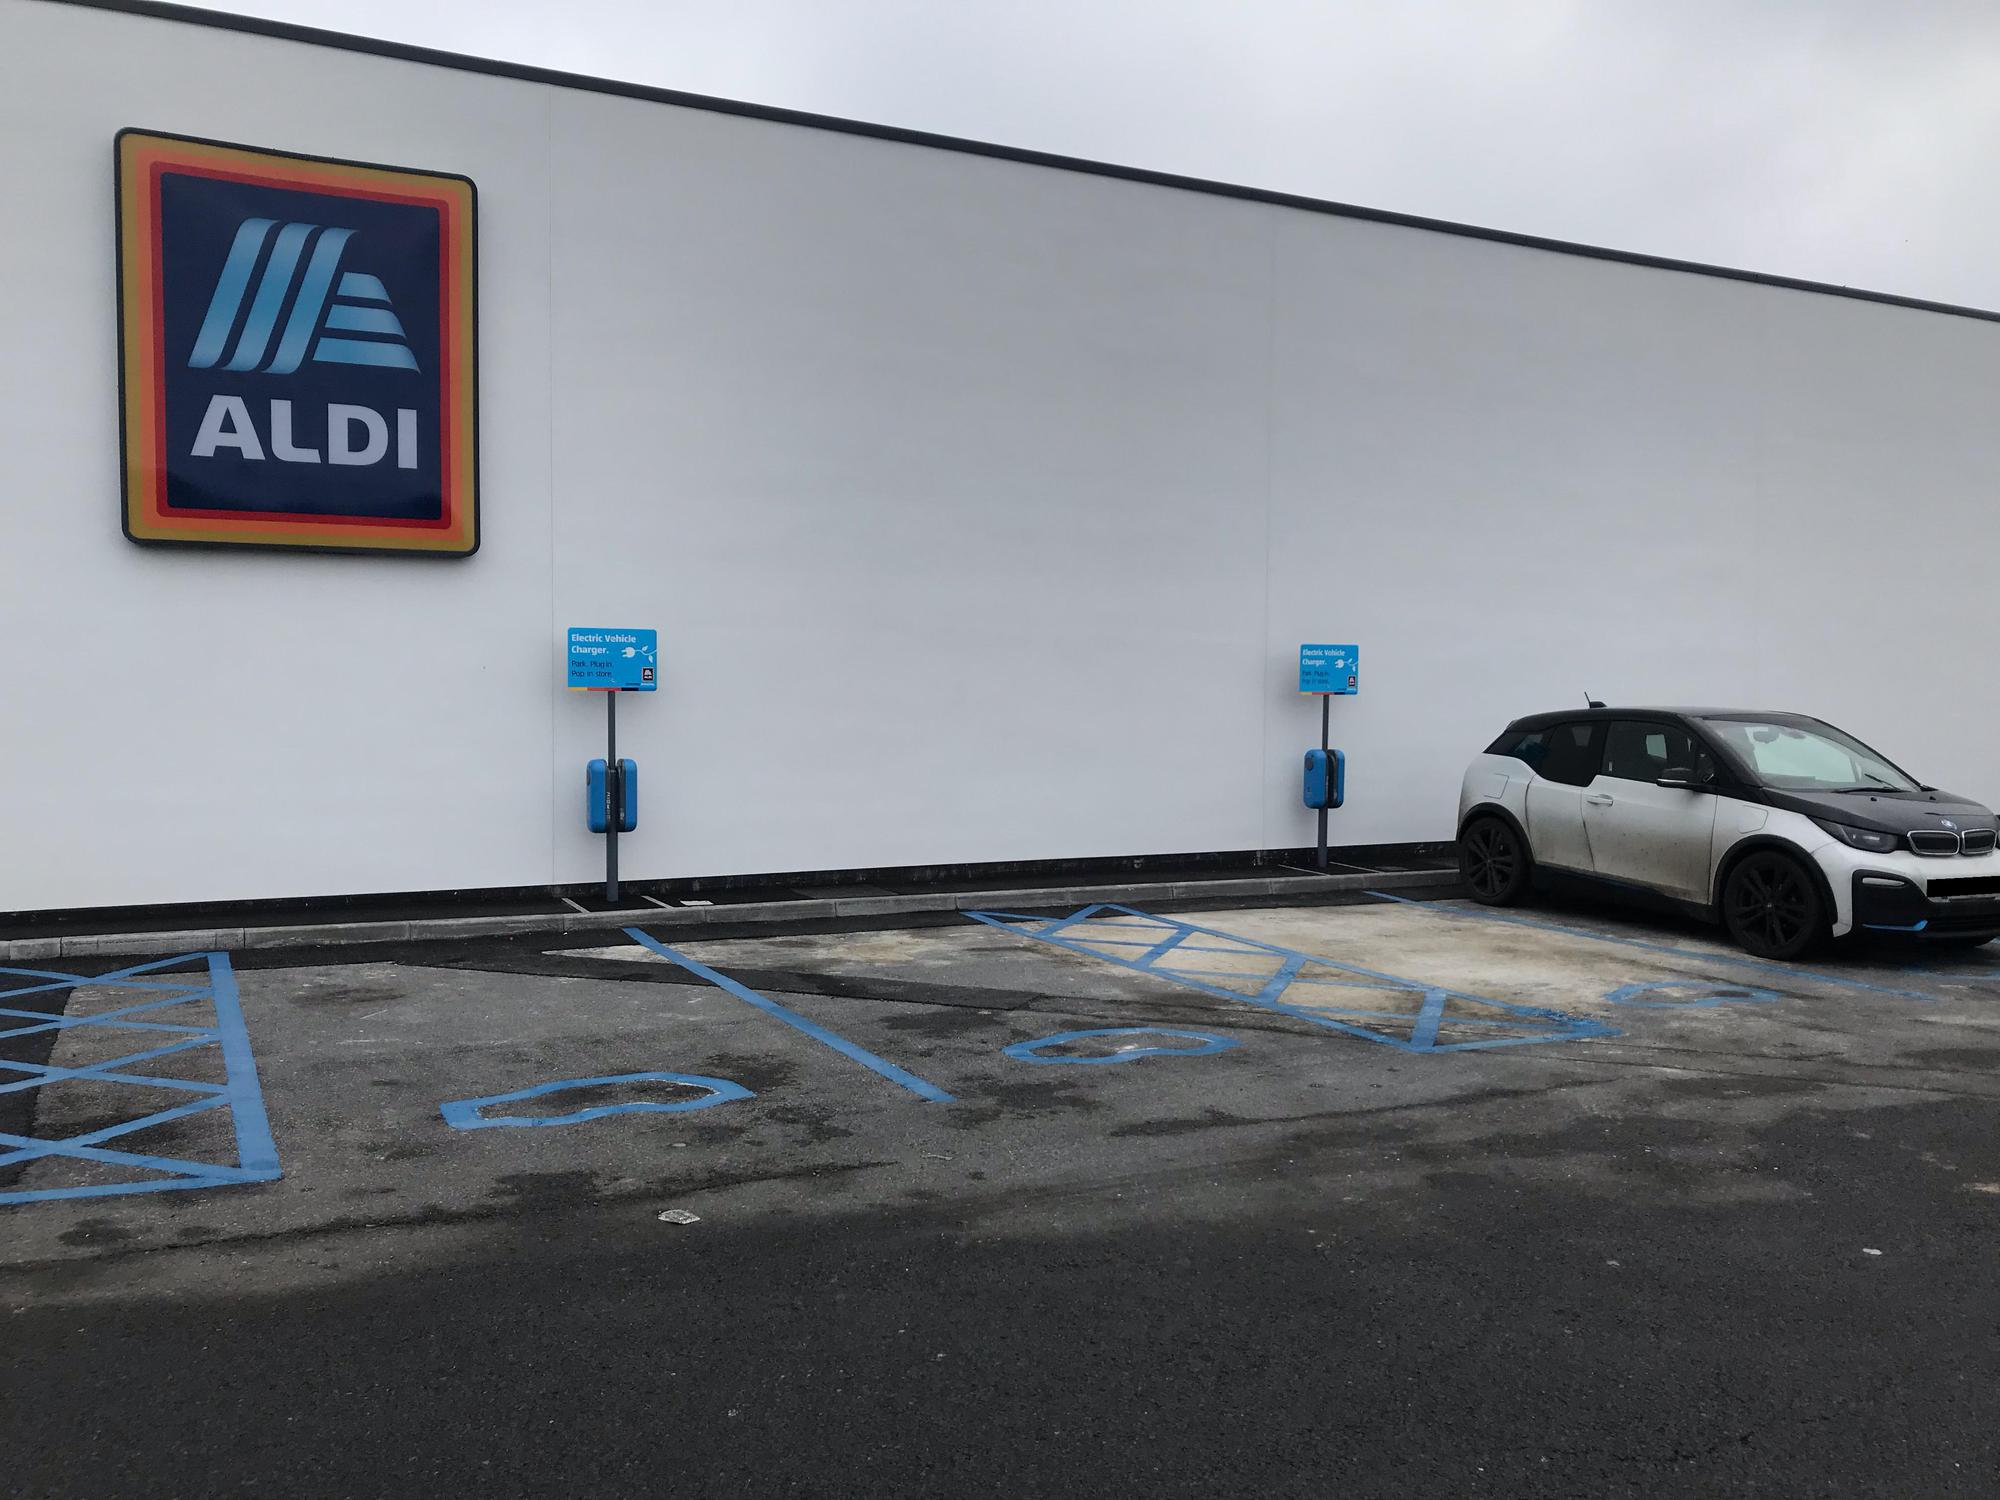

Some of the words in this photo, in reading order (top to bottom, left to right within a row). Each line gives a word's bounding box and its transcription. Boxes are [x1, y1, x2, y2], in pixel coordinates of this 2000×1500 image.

[190, 394, 418, 469] ALDI
[571, 634, 603, 642] Electric
[605, 635, 637, 643] Vehicle
[571, 646, 609, 655] Charger.
